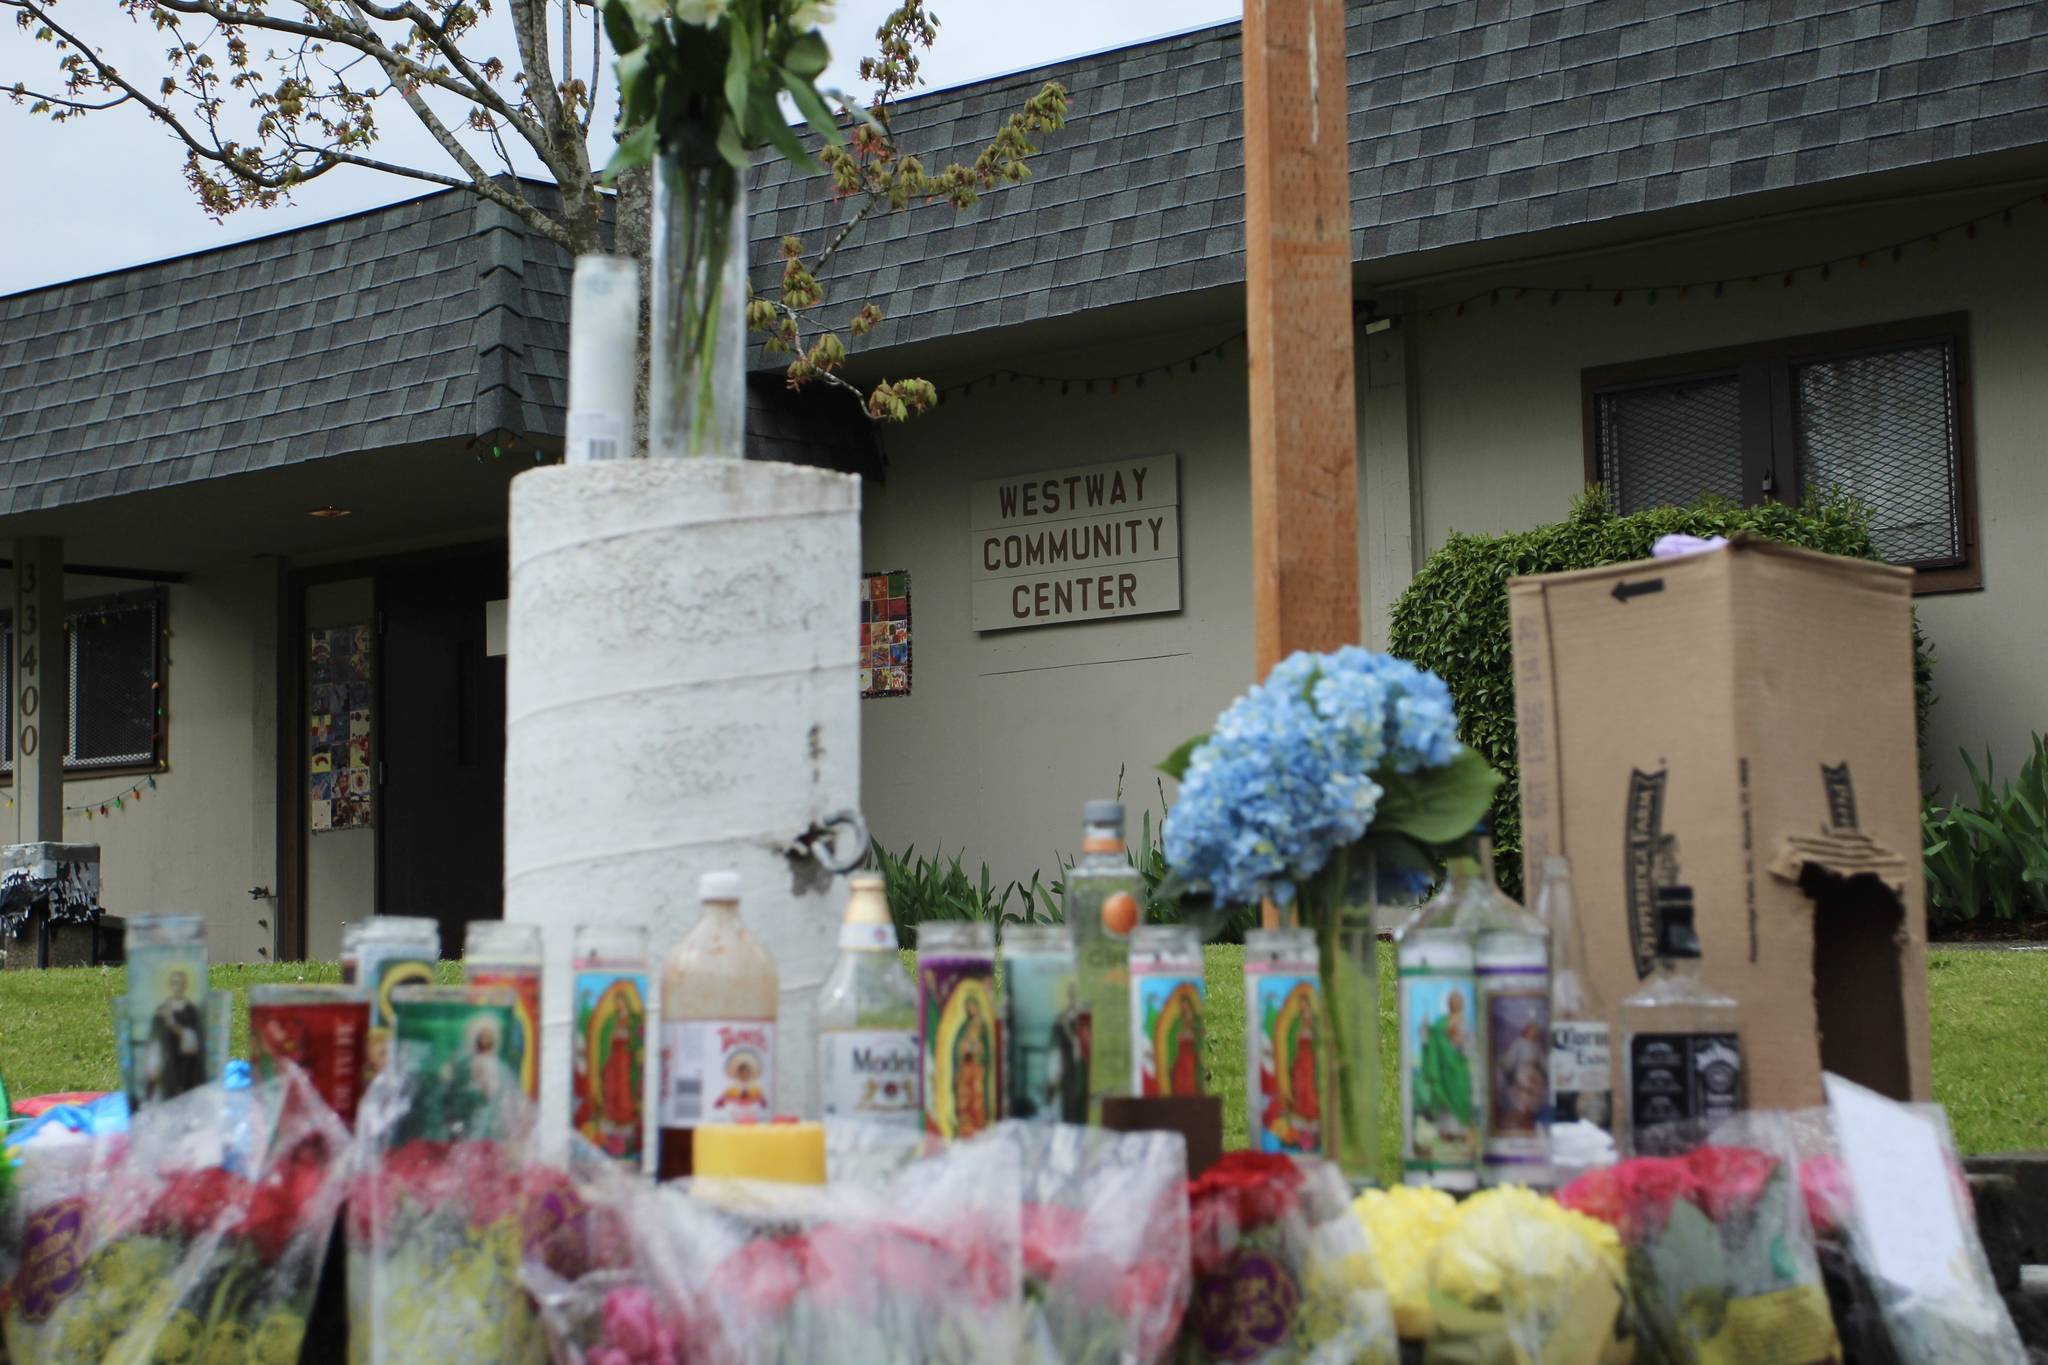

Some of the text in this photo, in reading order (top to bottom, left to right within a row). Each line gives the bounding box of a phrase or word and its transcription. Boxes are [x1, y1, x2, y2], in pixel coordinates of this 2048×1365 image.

[1000, 467, 1148, 519] WESTWAY
[983, 517, 1163, 571] COMMUNITY
[1012, 573, 1137, 619] CENTER
[20, 563, 39, 756] 33400
